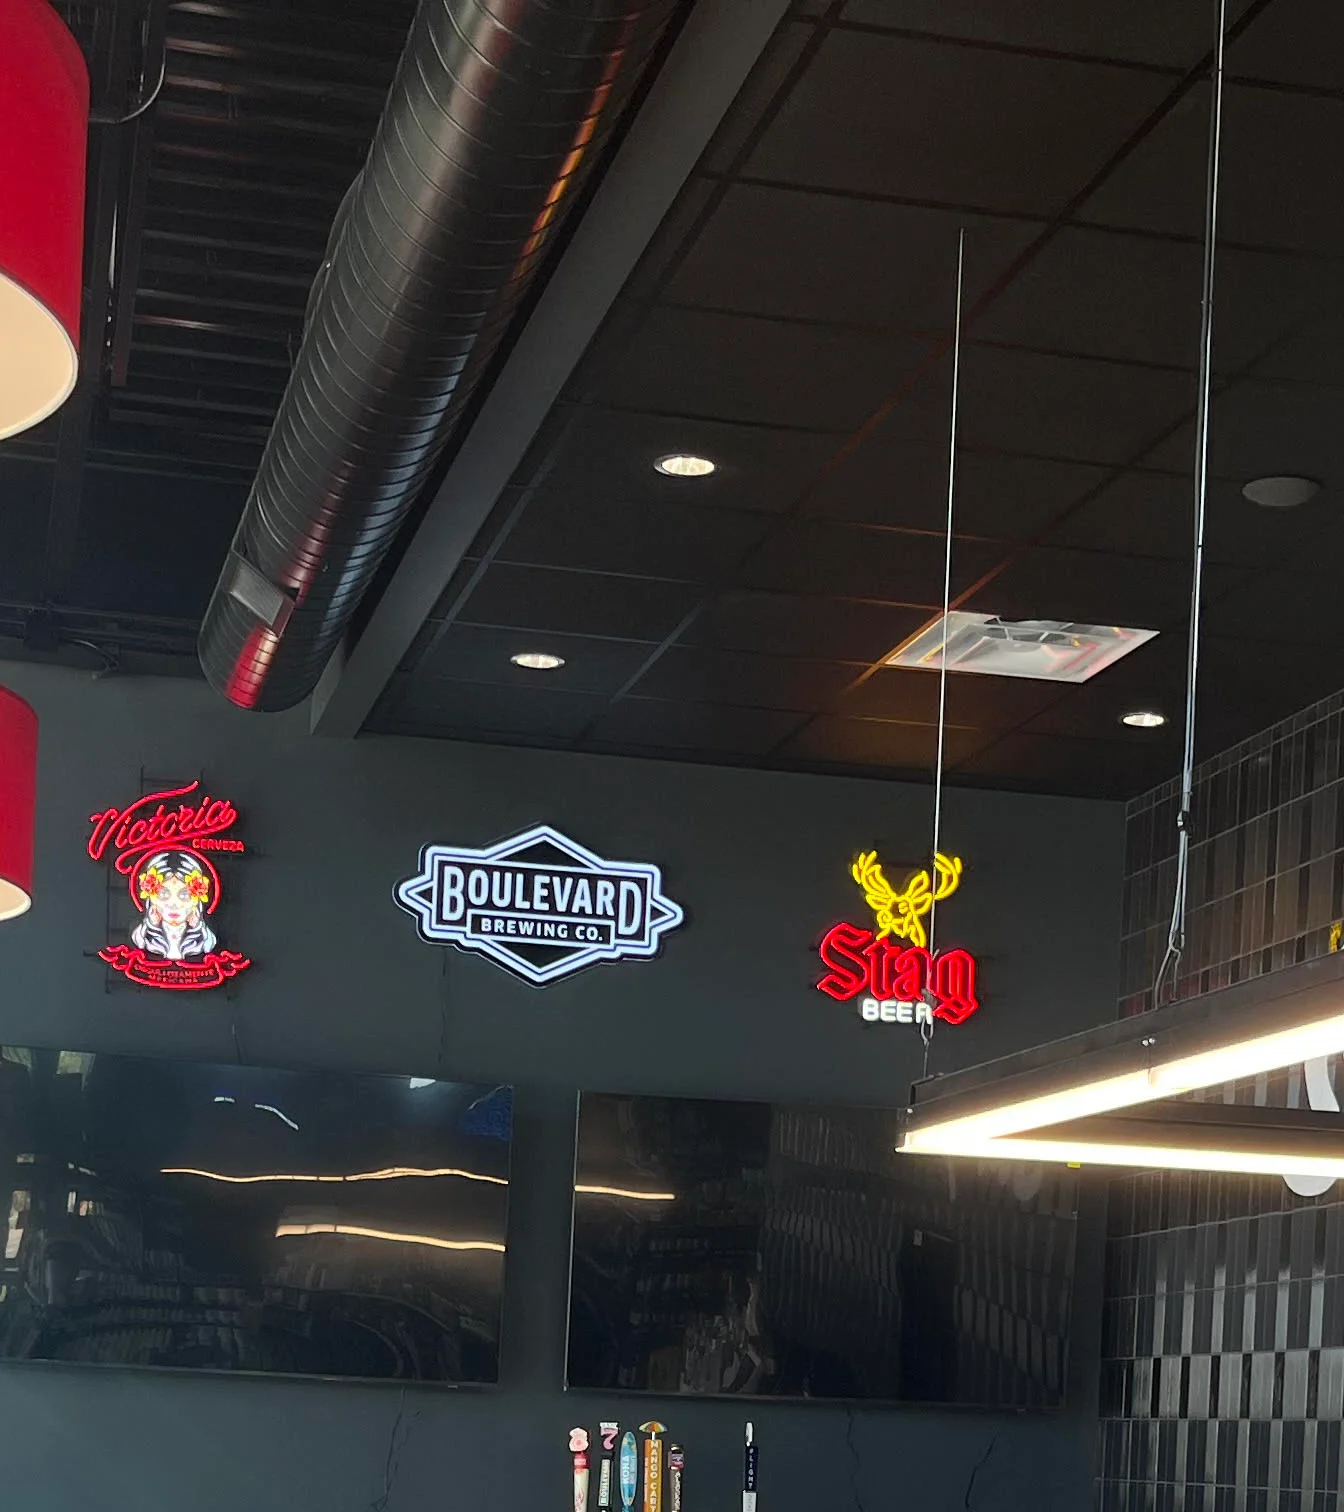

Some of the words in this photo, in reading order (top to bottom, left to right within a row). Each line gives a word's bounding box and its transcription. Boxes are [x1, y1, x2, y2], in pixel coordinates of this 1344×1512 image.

[88, 780, 239, 868] Victoria
[192, 838, 244, 853] CERVEZA
[441, 865, 642, 936] BOULEVARD
[480, 918, 568, 940] BREWING
[574, 925, 604, 942] CO.
[816, 922, 979, 1025] Stag
[862, 997, 934, 1025] BEER
[650, 1440, 659, 1479] MANGO
[649, 1483, 657, 1512] CART
